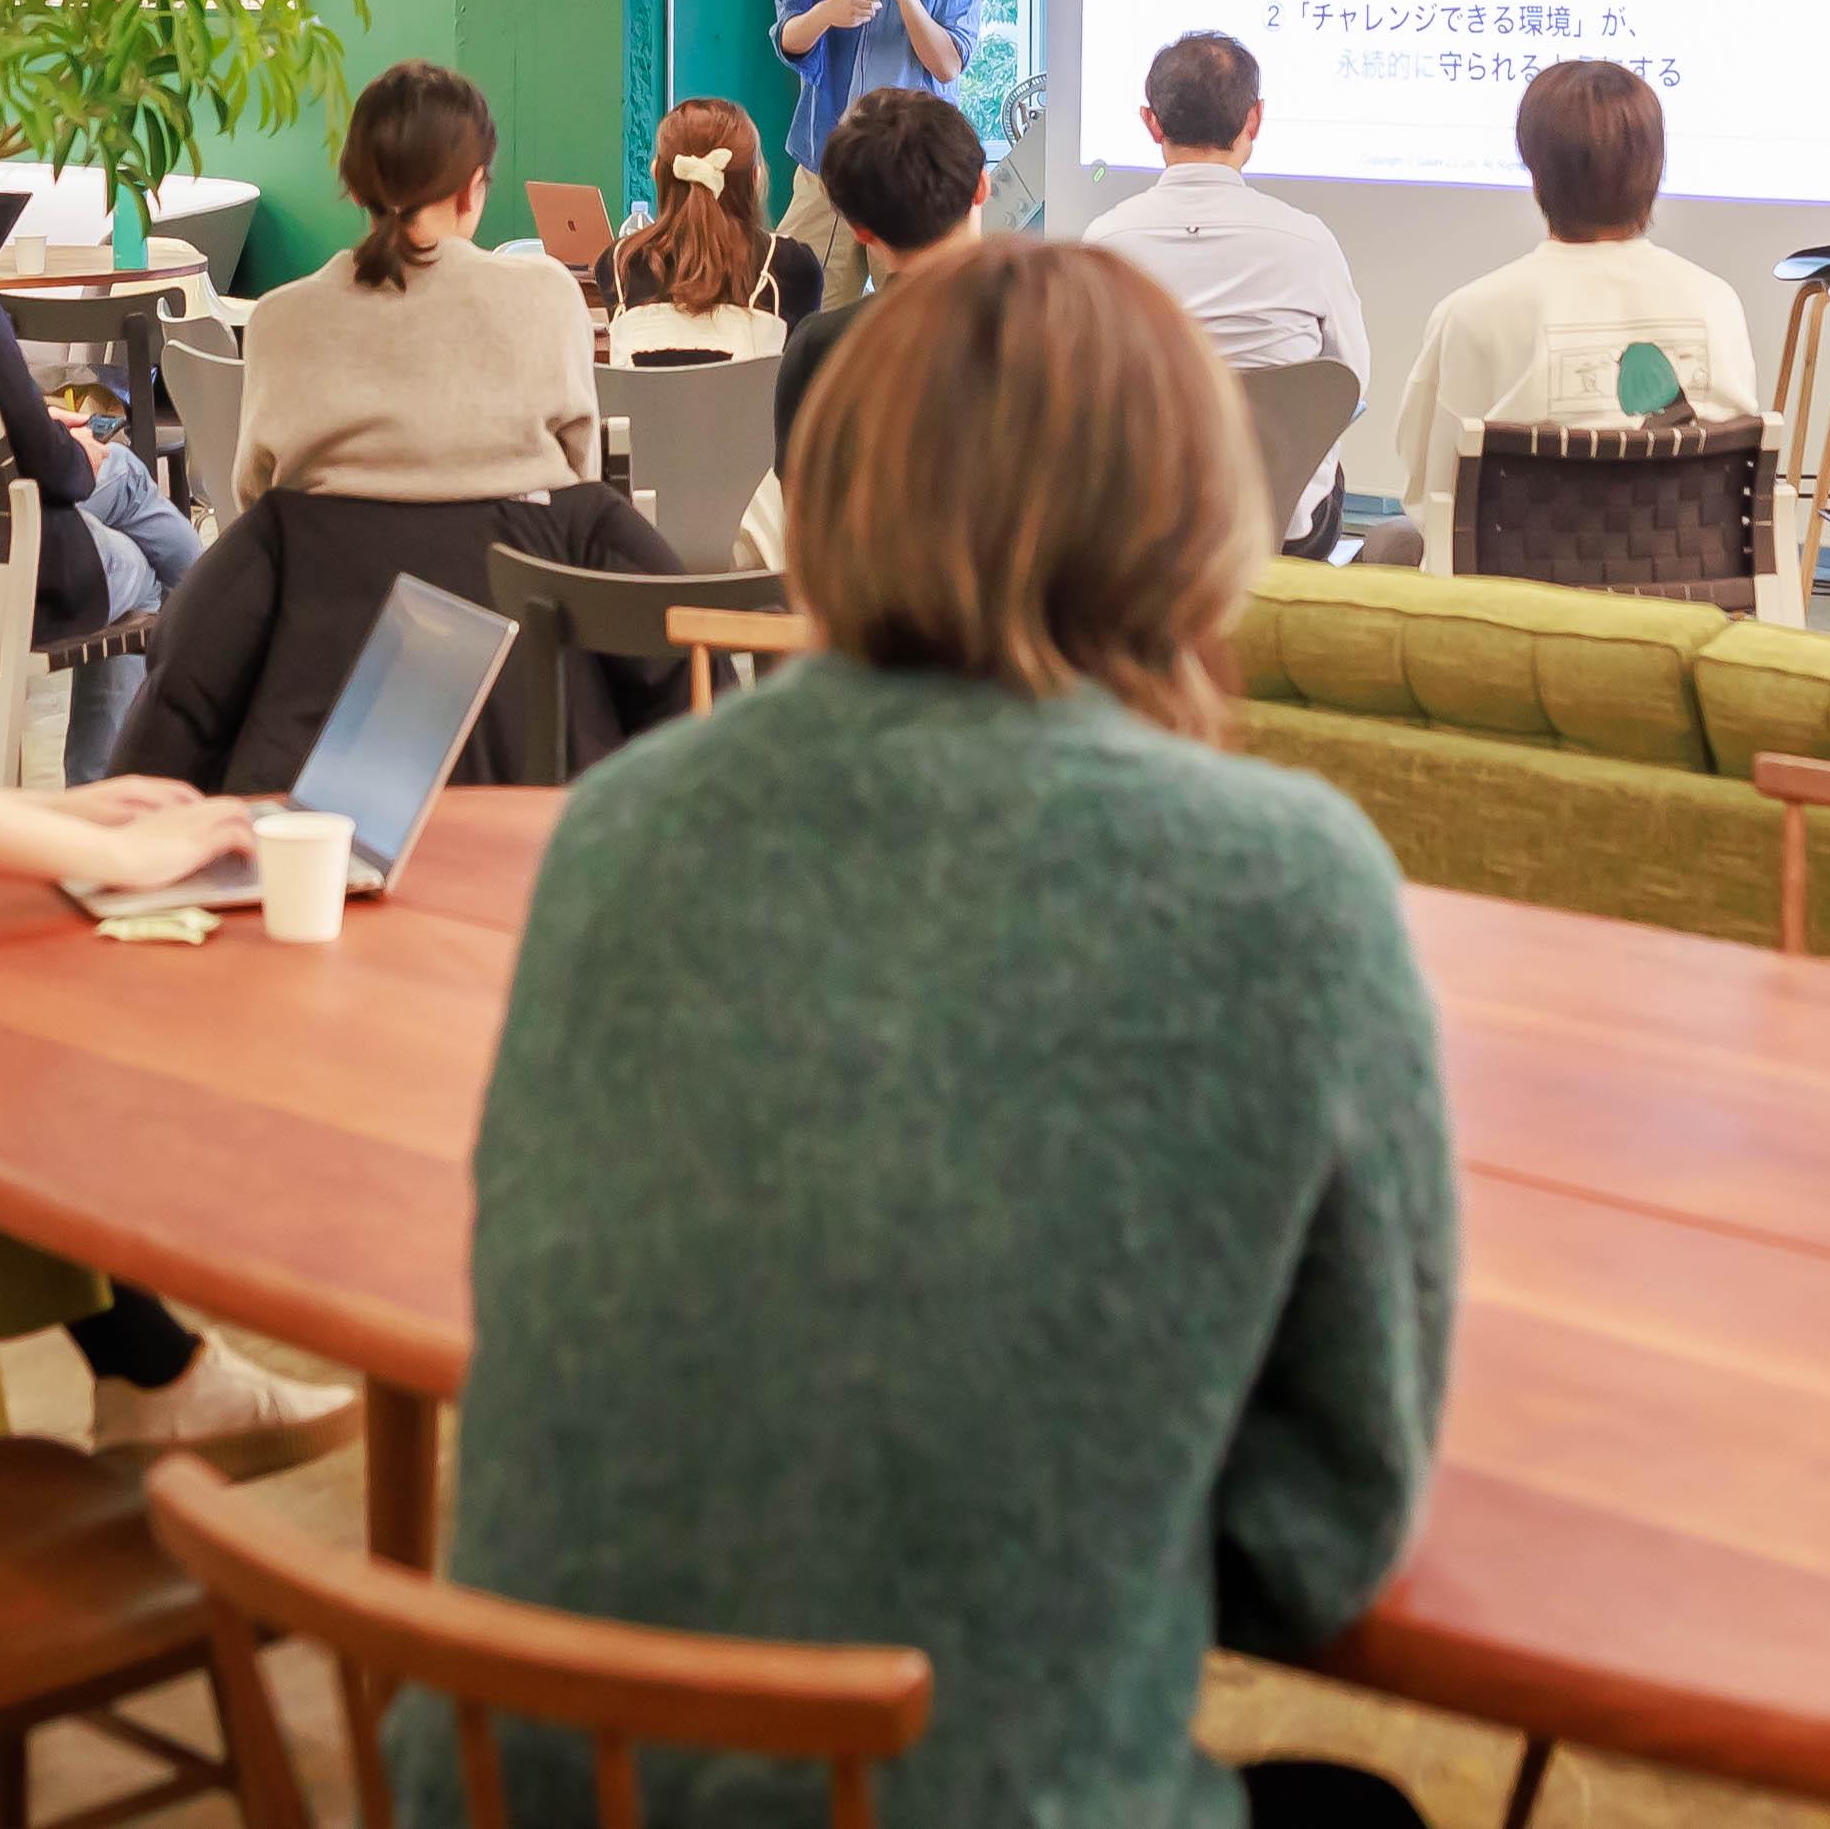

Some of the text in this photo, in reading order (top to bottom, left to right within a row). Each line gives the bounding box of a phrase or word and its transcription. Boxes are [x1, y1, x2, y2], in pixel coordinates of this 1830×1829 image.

[1336, 50, 1682, 87] 永続的に守られるする
